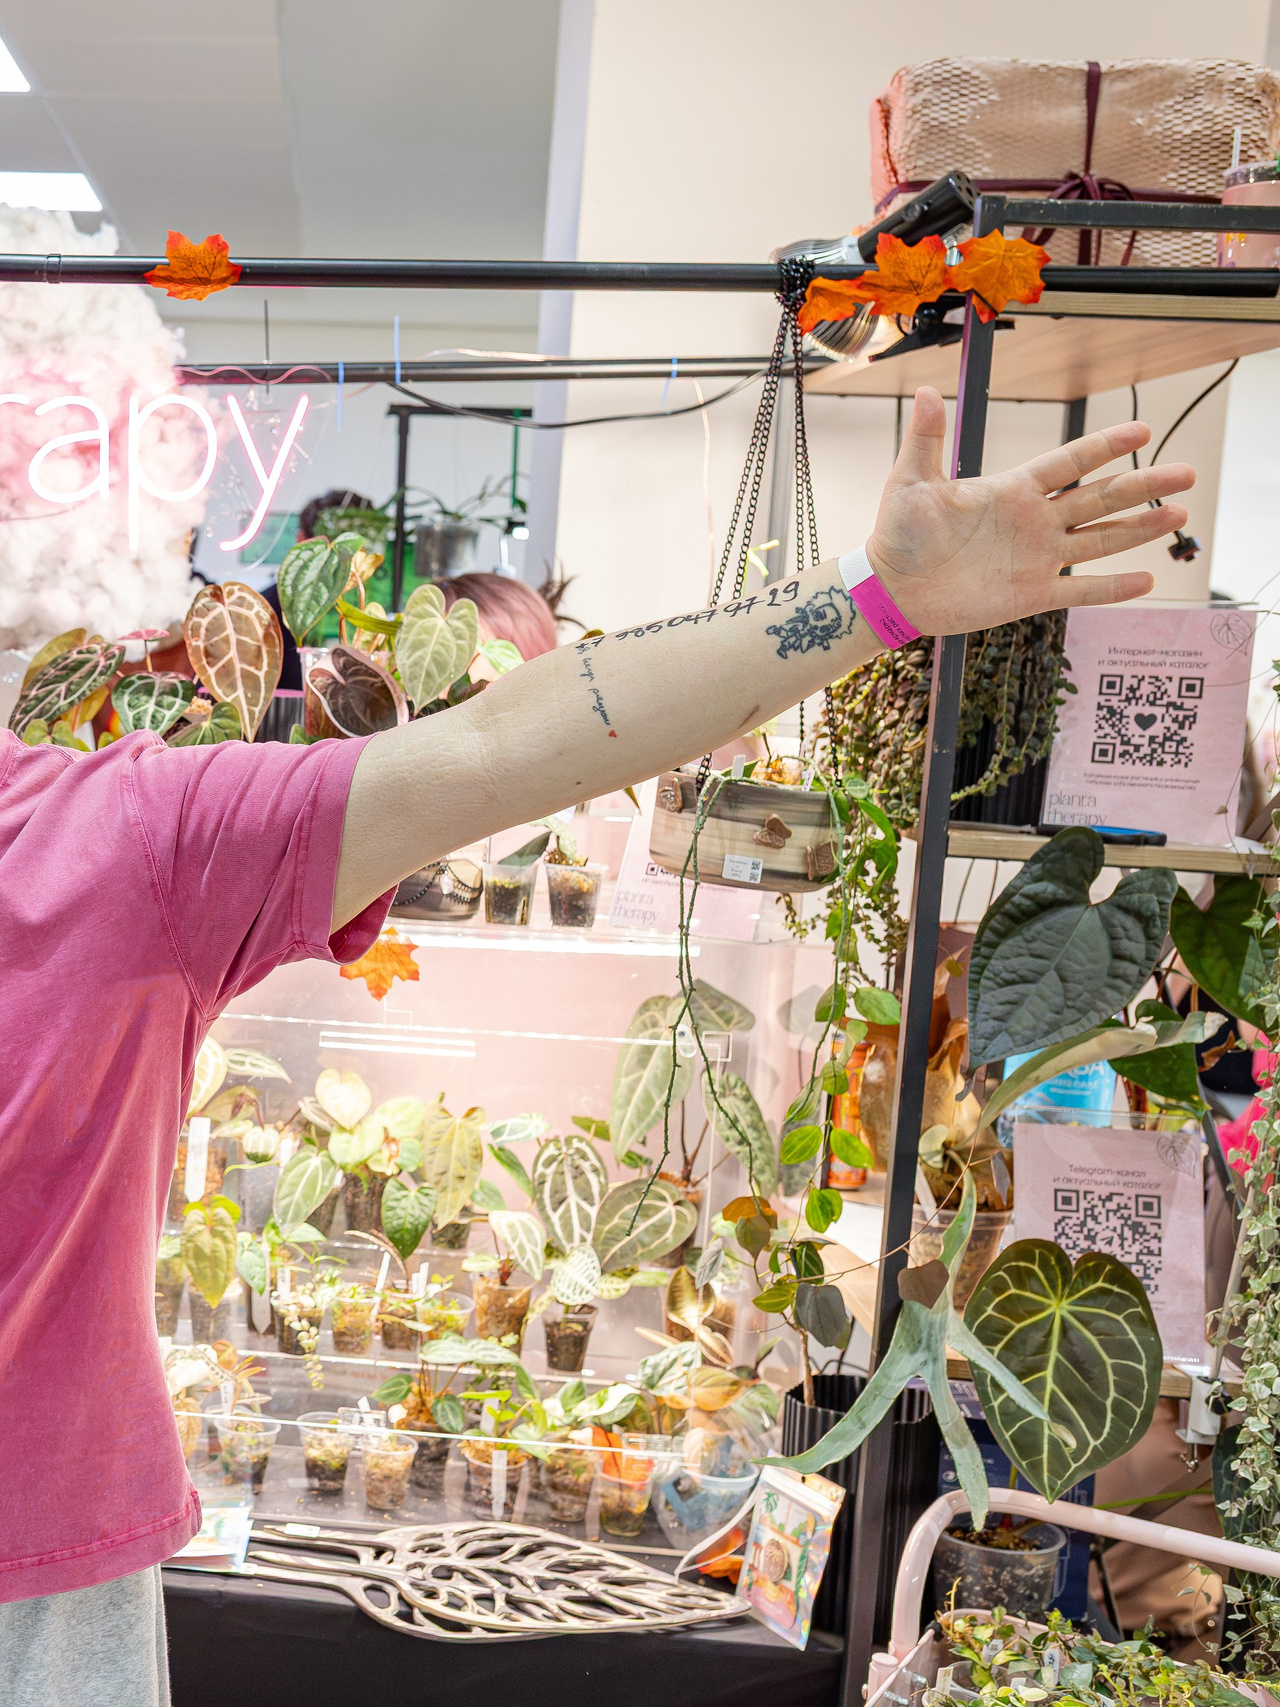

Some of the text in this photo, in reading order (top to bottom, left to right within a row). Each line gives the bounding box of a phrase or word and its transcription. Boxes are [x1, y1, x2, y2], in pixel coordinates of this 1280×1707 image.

[1108, 646, 1203, 658] Интернет-магазин
[1107, 659, 1168, 669] актуальный
[1169, 661, 1211, 669] каталог
[1048, 791, 1098, 808] planta
[1047, 809, 1108, 826] therapy
[616, 889, 654, 905] planta
[613, 905, 661, 925] therapy
[1069, 1164, 1147, 1178] Telegram-канал
[1062, 1177, 1120, 1188] актуальный
[1122, 1180, 1162, 1190] каталог
